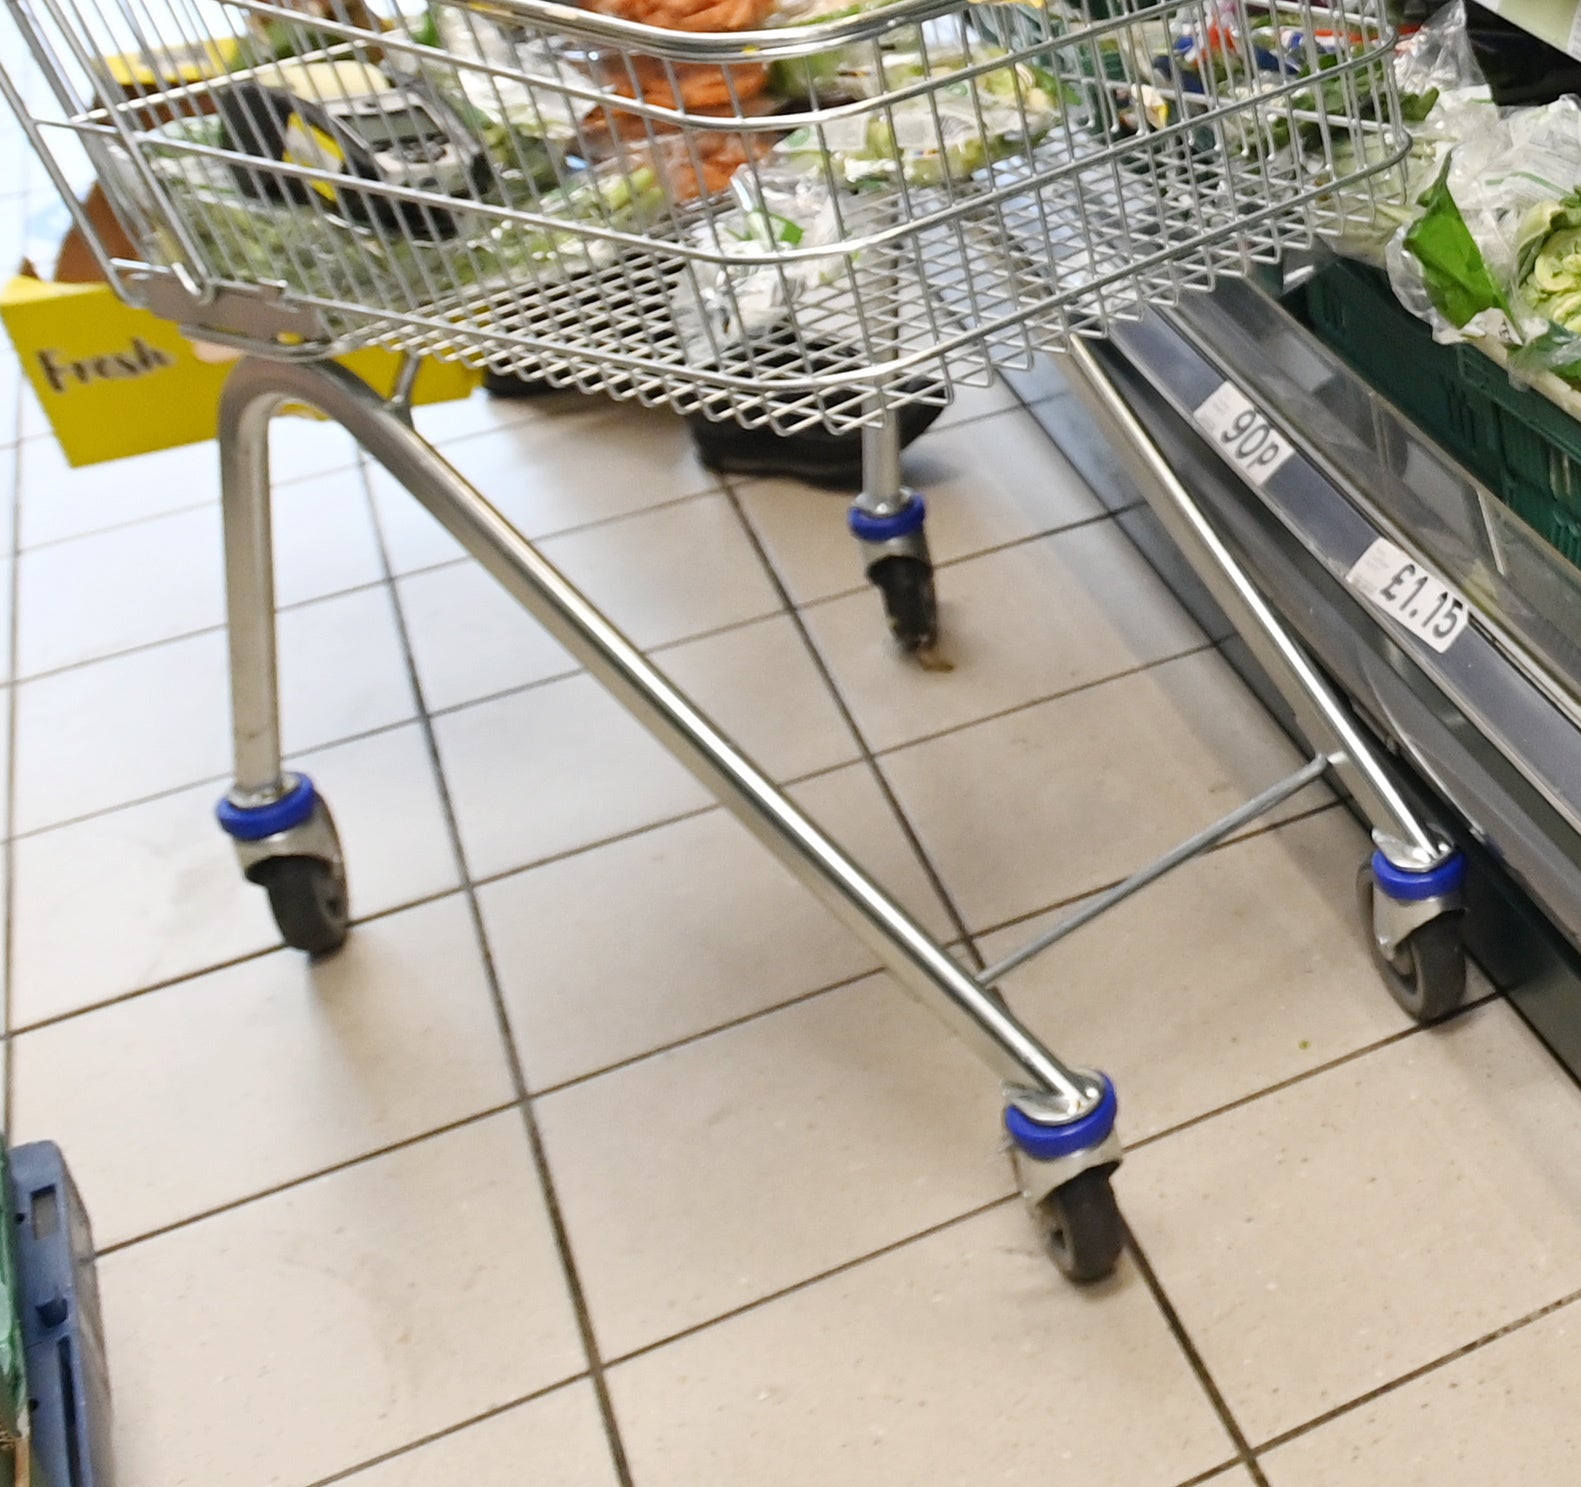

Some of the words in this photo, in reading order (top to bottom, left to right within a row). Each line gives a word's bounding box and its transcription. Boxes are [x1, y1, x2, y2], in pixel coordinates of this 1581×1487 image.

[36, 337, 174, 394] Fresh
[1220, 412, 1279, 468] 90p
[1379, 563, 1464, 639] £1.15
